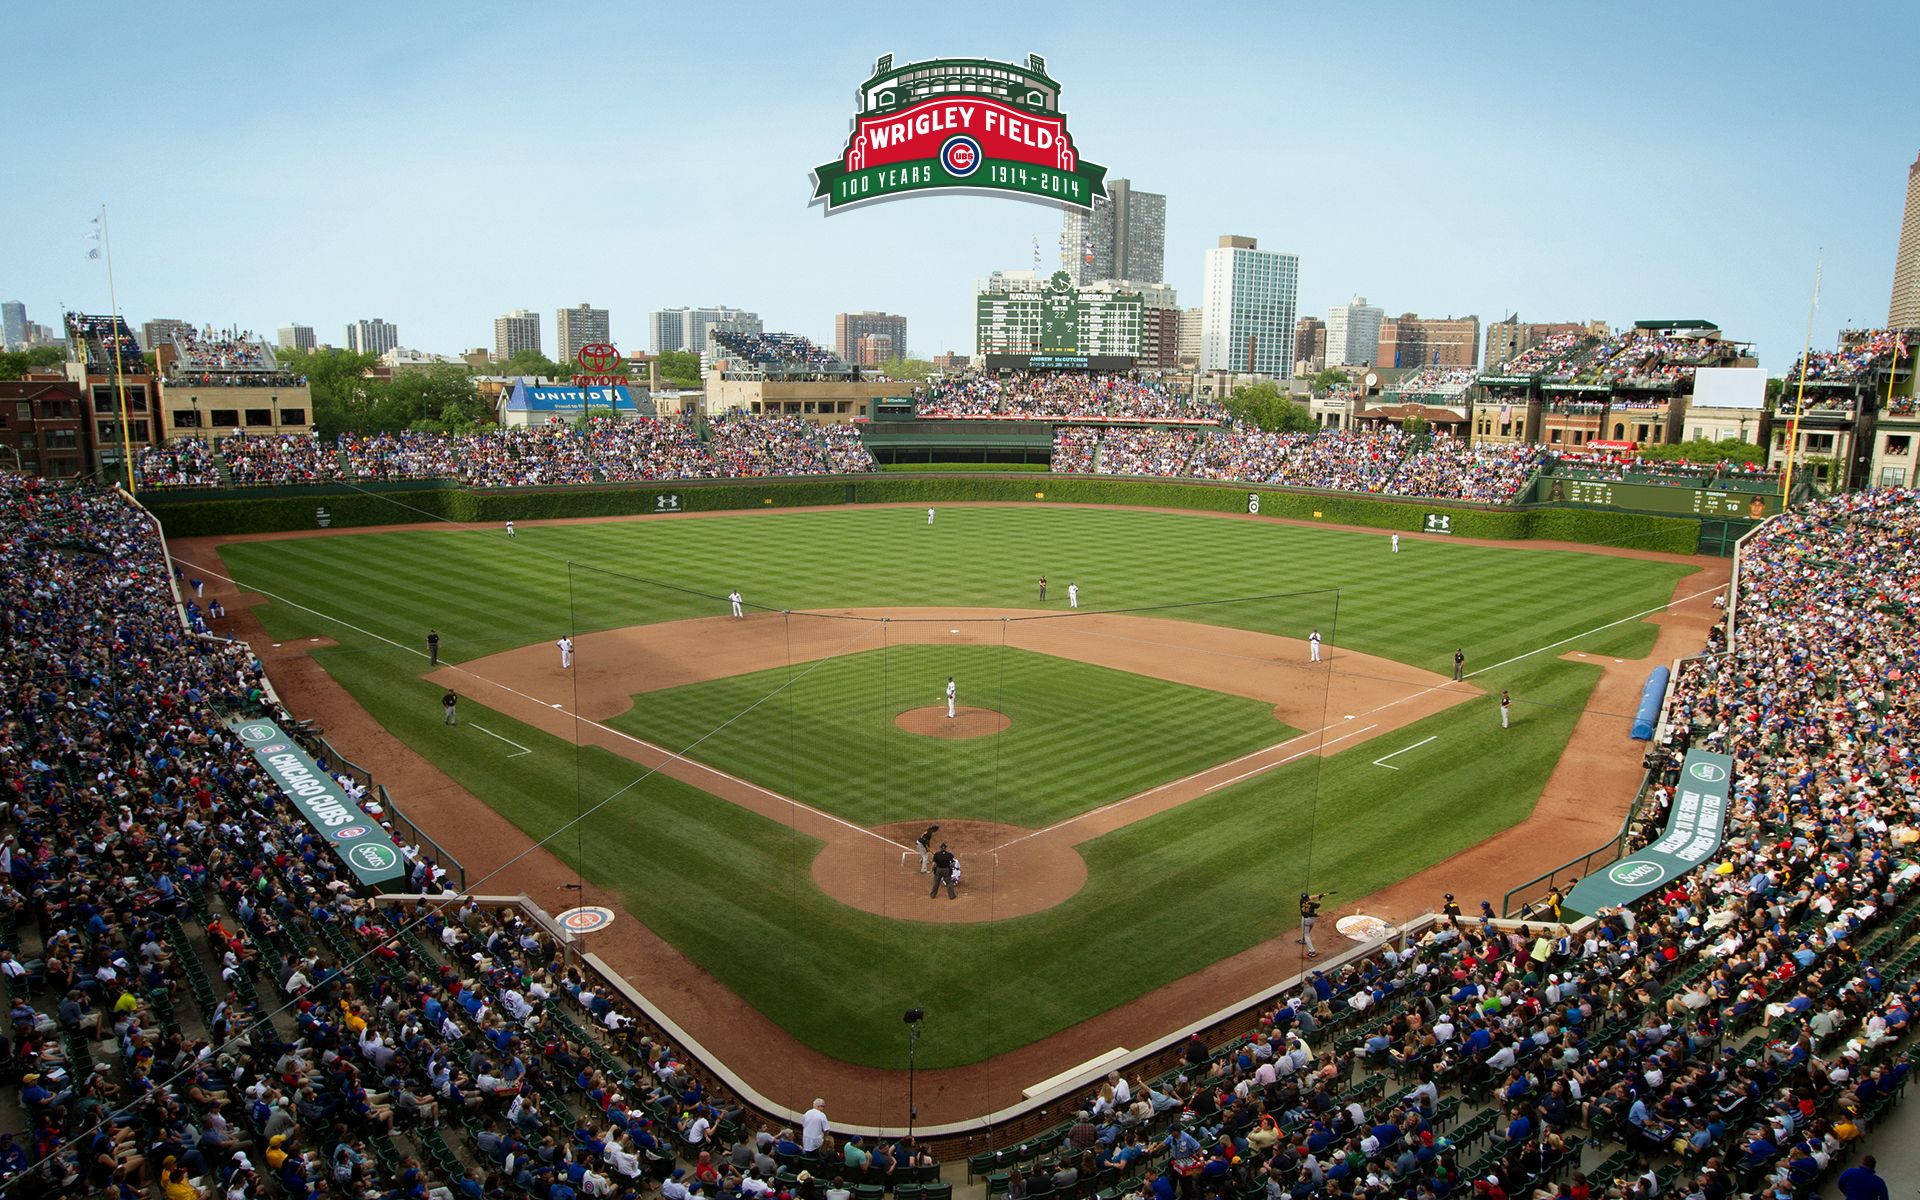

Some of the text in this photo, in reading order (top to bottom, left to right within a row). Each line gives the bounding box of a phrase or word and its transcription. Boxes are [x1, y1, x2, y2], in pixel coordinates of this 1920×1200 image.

[1009, 293, 1043, 301] NATIONAL
[1054, 311, 1066, 319] 22
[571, 375, 629, 387] TOYOTA
[534, 391, 601, 401] UNITED
[1586, 442, 1628, 450] Budweiser
[1727, 503, 1738, 511] 10
[268, 753, 326, 797] CHICAGO
[306, 794, 355, 827] CUBS
[1617, 862, 1656, 883] Scotts
